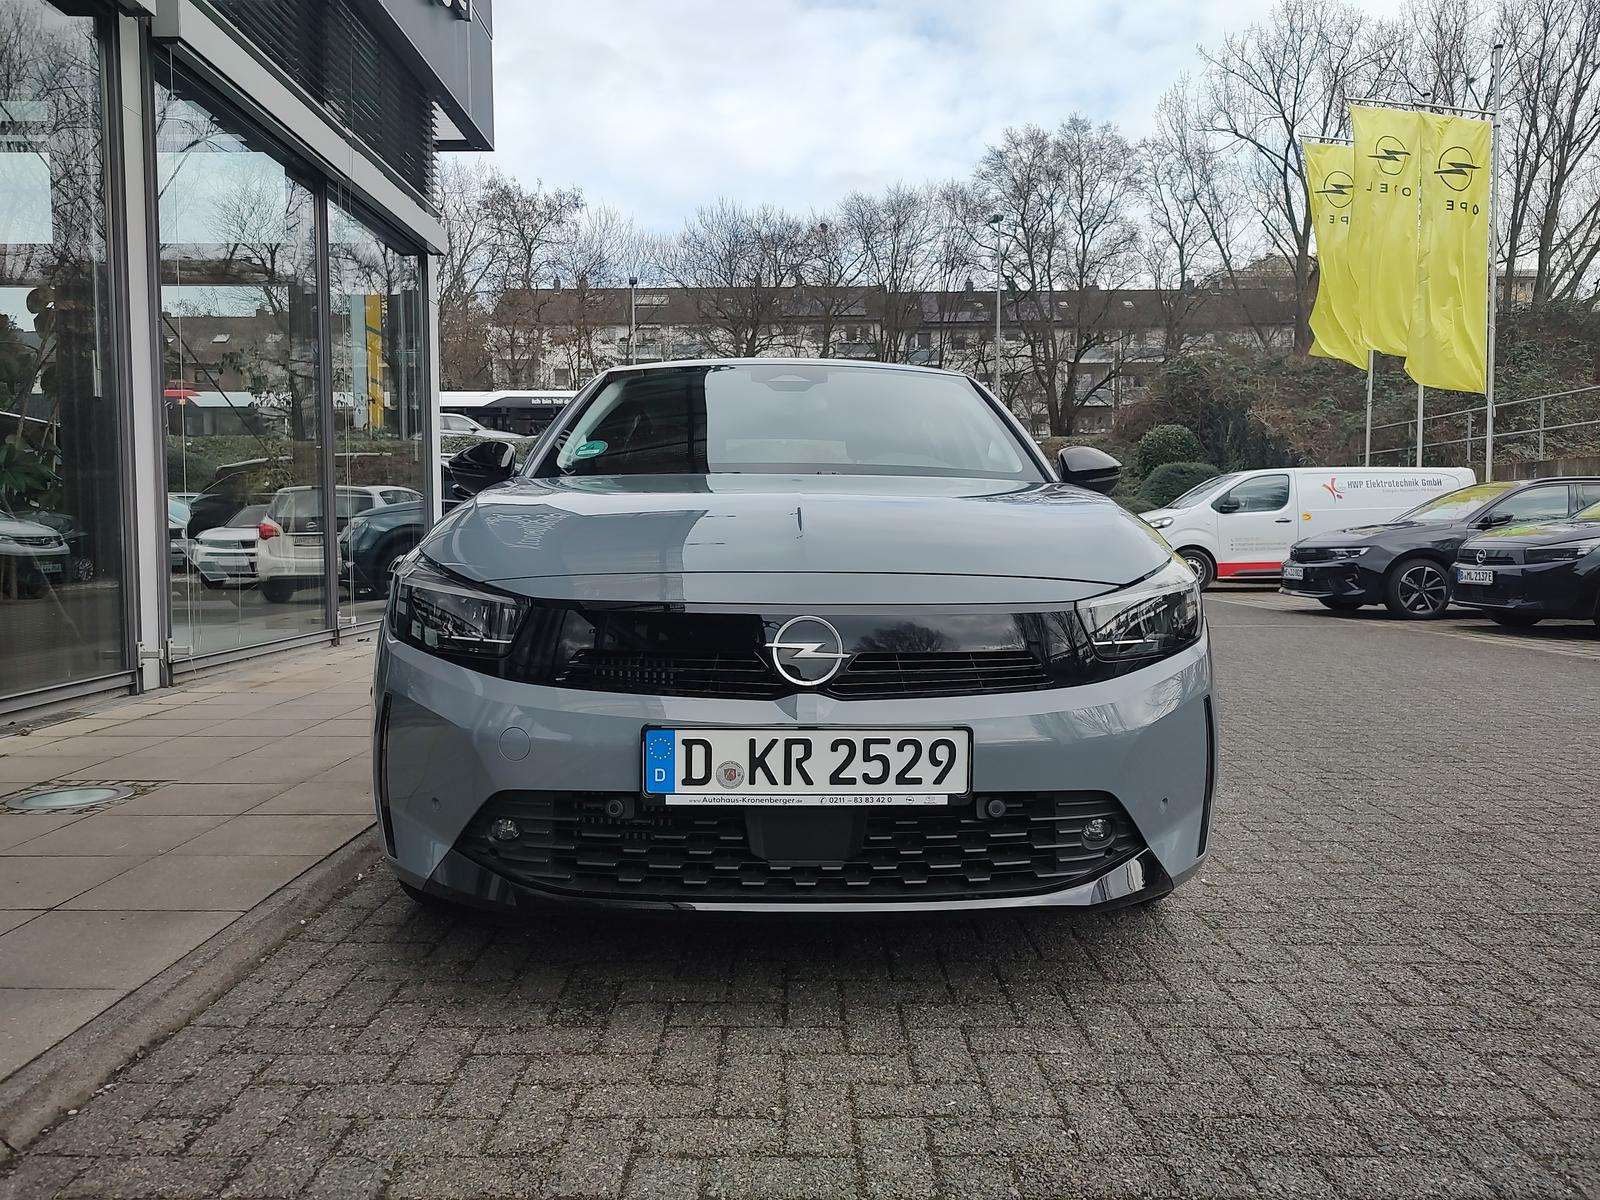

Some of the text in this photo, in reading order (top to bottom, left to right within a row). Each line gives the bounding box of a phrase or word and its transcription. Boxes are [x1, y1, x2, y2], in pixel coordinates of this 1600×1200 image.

[1347, 478, 1443, 489] HWP Elektrotechnik GmbH
[681, 738, 713, 786] D
[748, 738, 814, 786] KR
[828, 738, 957, 786] 2529
[655, 768, 666, 782] D
